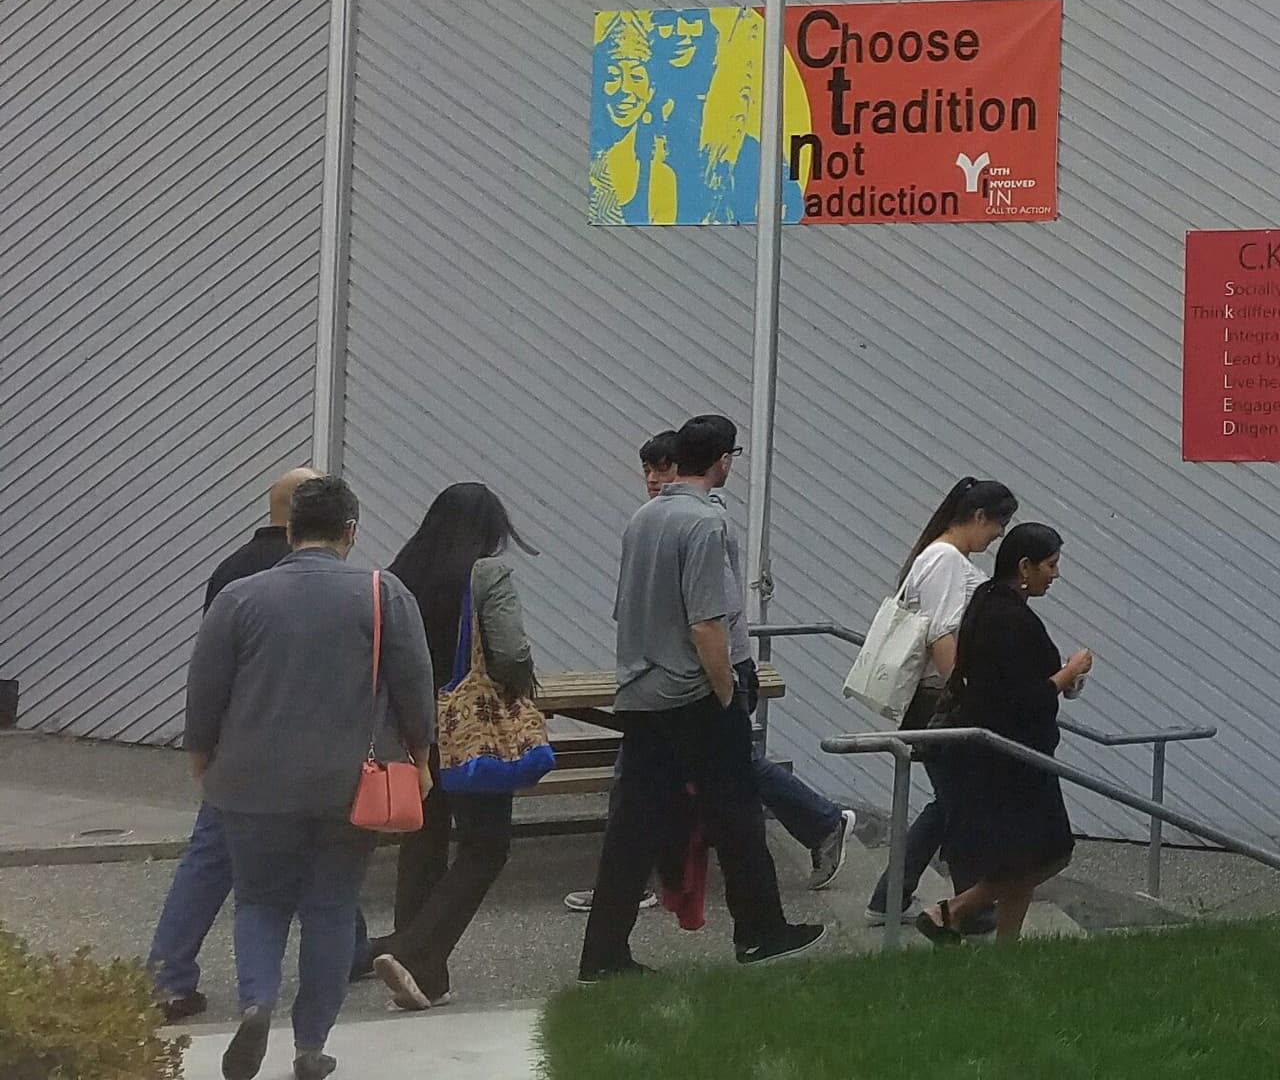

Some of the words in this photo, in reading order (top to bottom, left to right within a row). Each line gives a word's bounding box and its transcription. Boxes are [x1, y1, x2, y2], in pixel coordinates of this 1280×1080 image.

[797, 9, 980, 69] Choose
[827, 67, 1037, 135] tradition
[789, 133, 865, 181] not
[804, 185, 959, 217] addiction
[989, 189, 1011, 207] IN
[1019, 206, 1051, 214] ACTION
[1191, 304, 1234, 320] Think
[1224, 350, 1261, 365] Lead
[1223, 373, 1255, 389] Live
